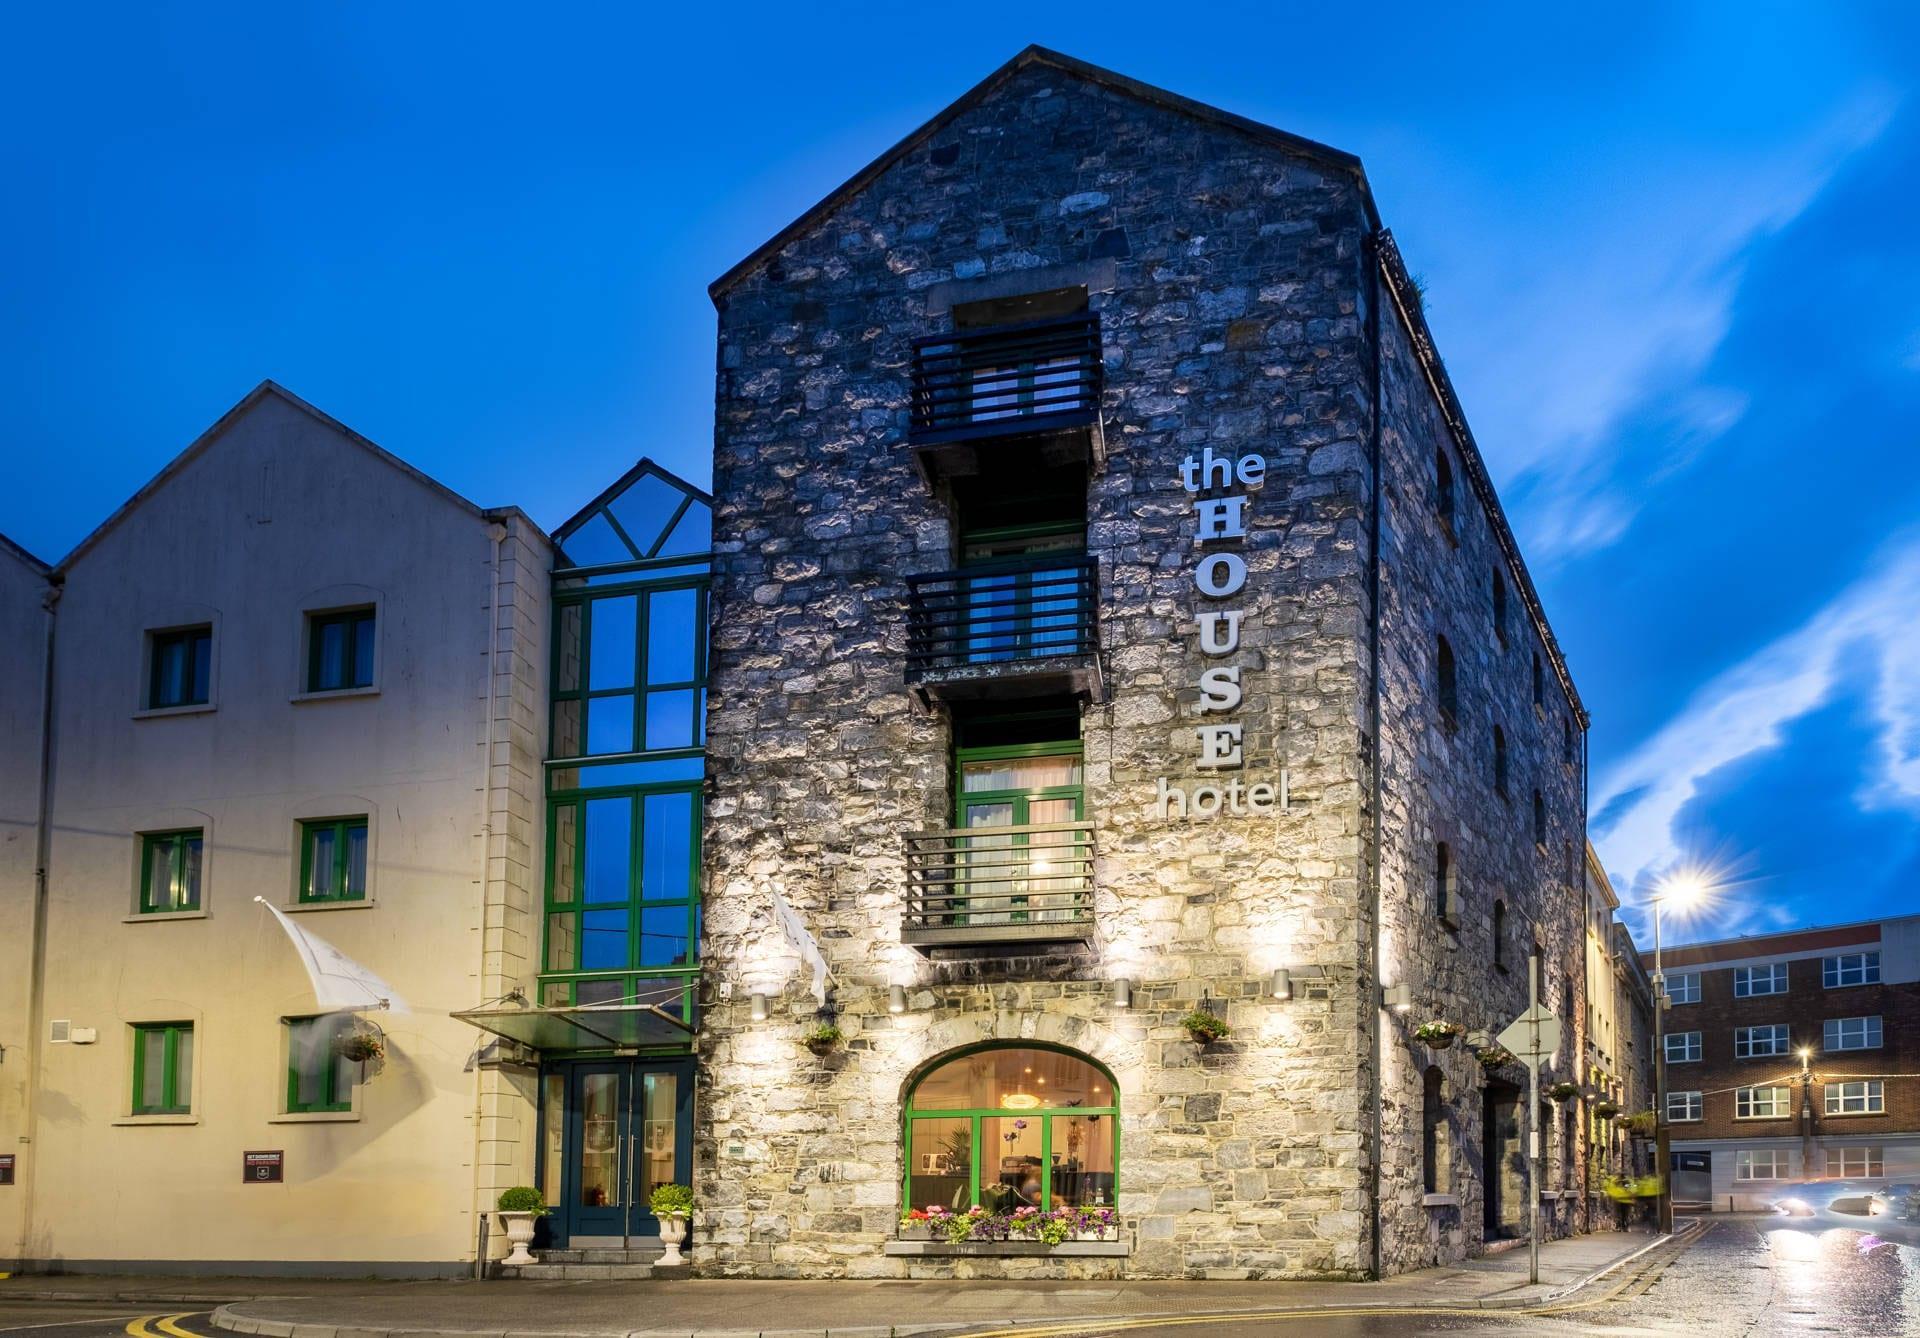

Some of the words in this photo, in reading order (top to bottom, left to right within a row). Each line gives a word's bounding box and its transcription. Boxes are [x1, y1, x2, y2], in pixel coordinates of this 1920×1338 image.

[1179, 447, 1267, 493] the
[1193, 495, 1248, 770] HOUSE
[1156, 770, 1291, 820] hotel
